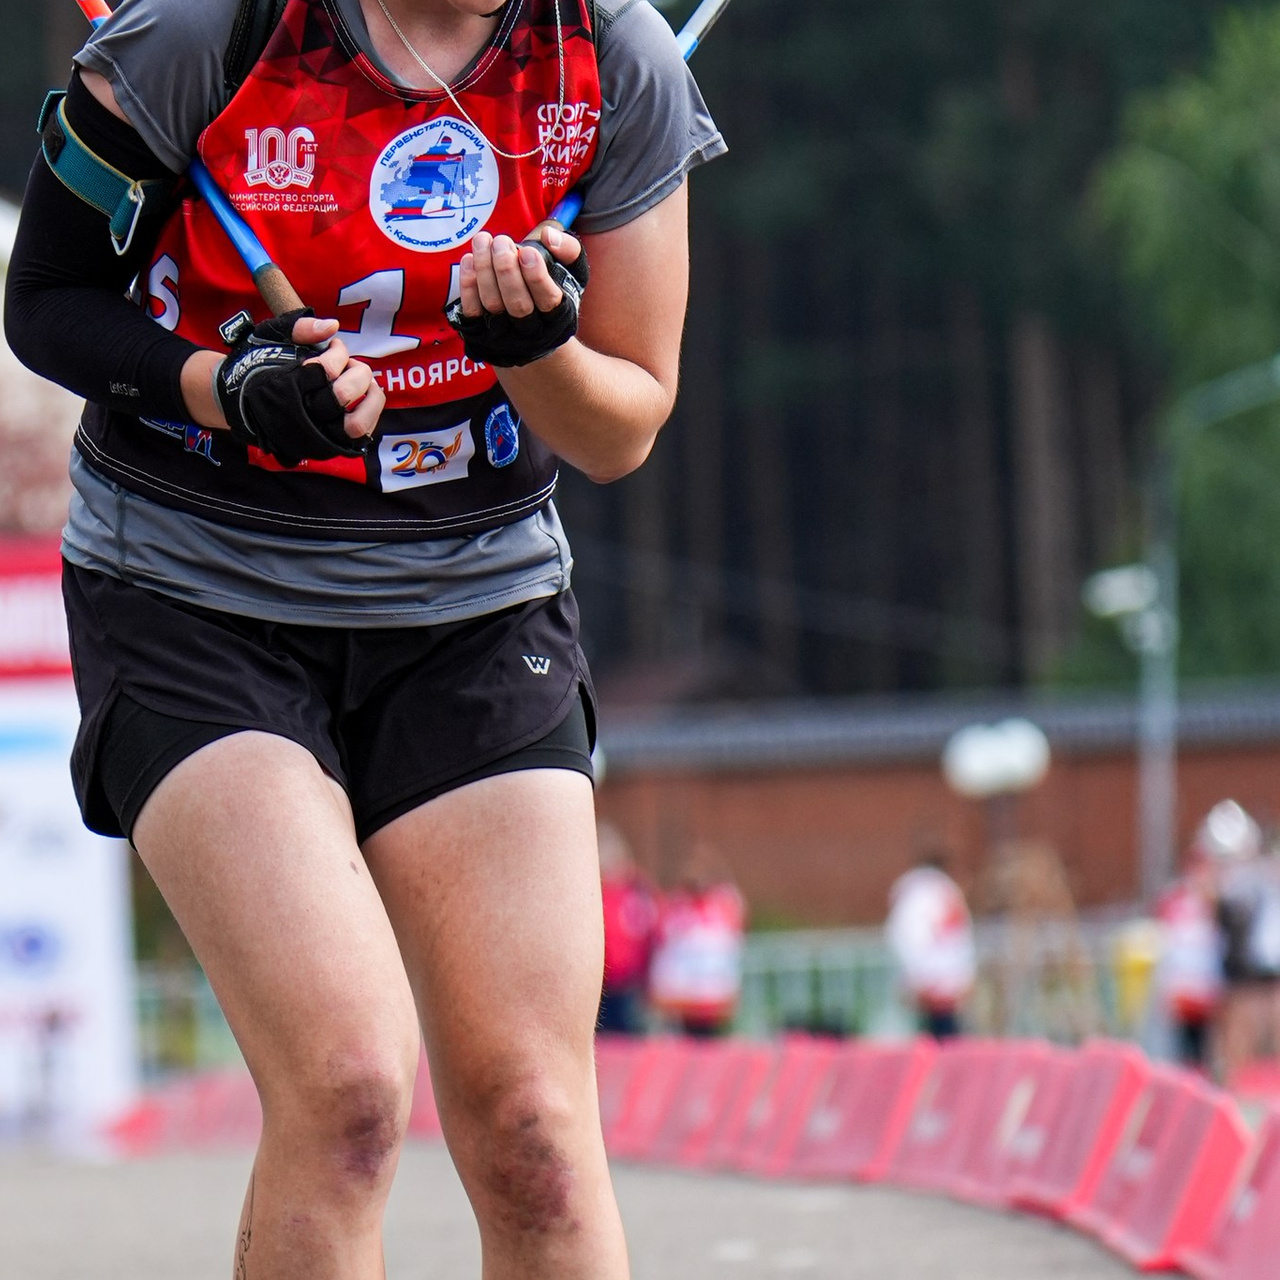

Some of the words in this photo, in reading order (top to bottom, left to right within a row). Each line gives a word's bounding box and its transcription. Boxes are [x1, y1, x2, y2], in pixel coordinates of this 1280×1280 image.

[244, 126, 315, 173] 100
[300, 143, 318, 152] ЛЕТ
[380, 120, 441, 166] ПЕРВЕНСТВО
[443, 120, 485, 151] РОССИИ
[229, 193, 299, 202] МИНИСТЕРСТВО
[300, 194, 335, 202] СПОРТА
[282, 203, 339, 213] ФЕДЕРАЦИИ
[394, 230, 453, 247] Красноярск
[455, 217, 479, 239] 2023
